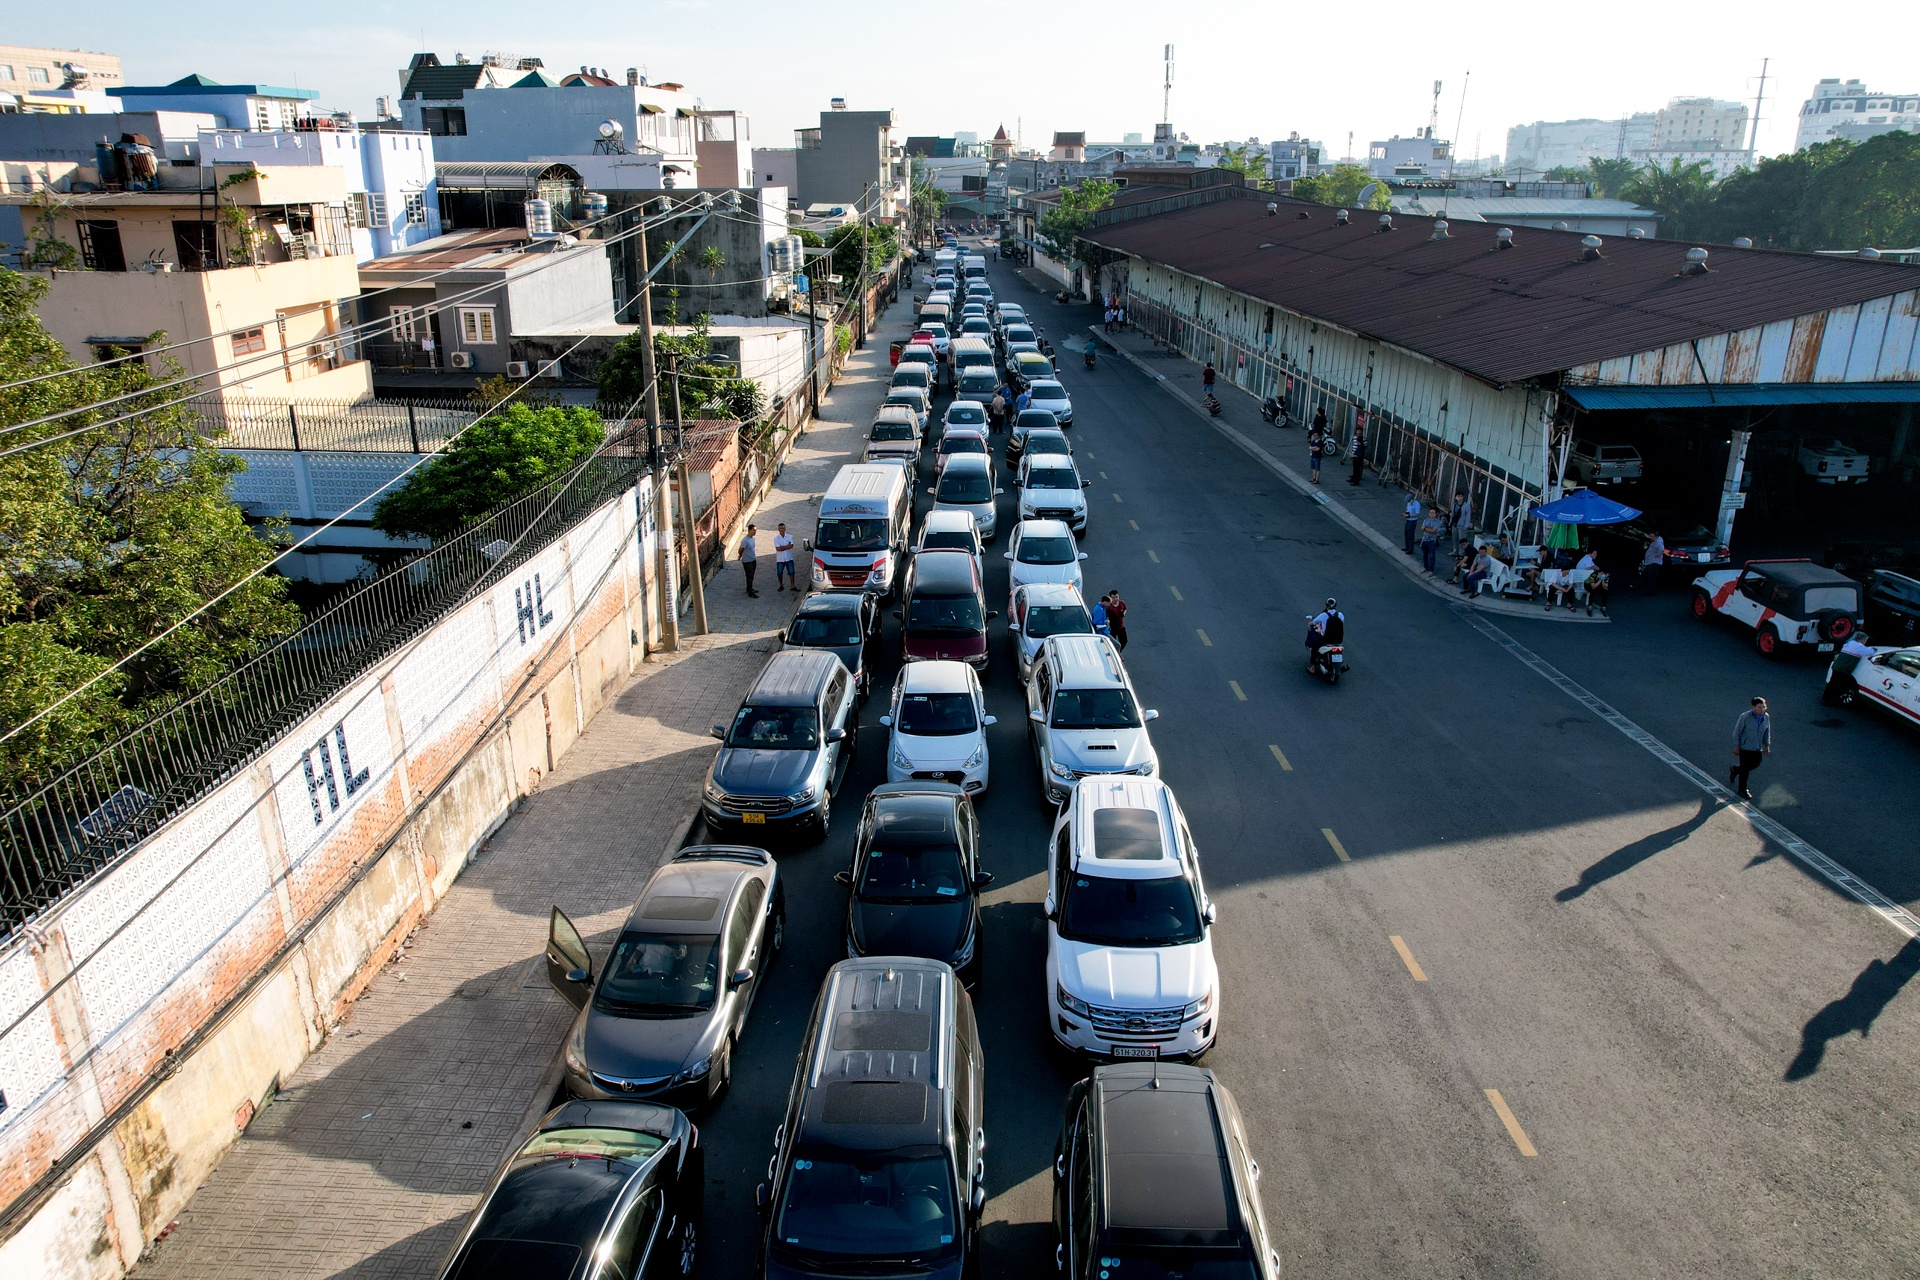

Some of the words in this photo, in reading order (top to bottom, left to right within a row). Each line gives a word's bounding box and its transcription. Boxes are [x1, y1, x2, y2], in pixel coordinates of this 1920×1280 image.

[515, 572, 554, 646] HL
[303, 724, 370, 827] HL
[1115, 1049, 1155, 1057] 51H-320.31
